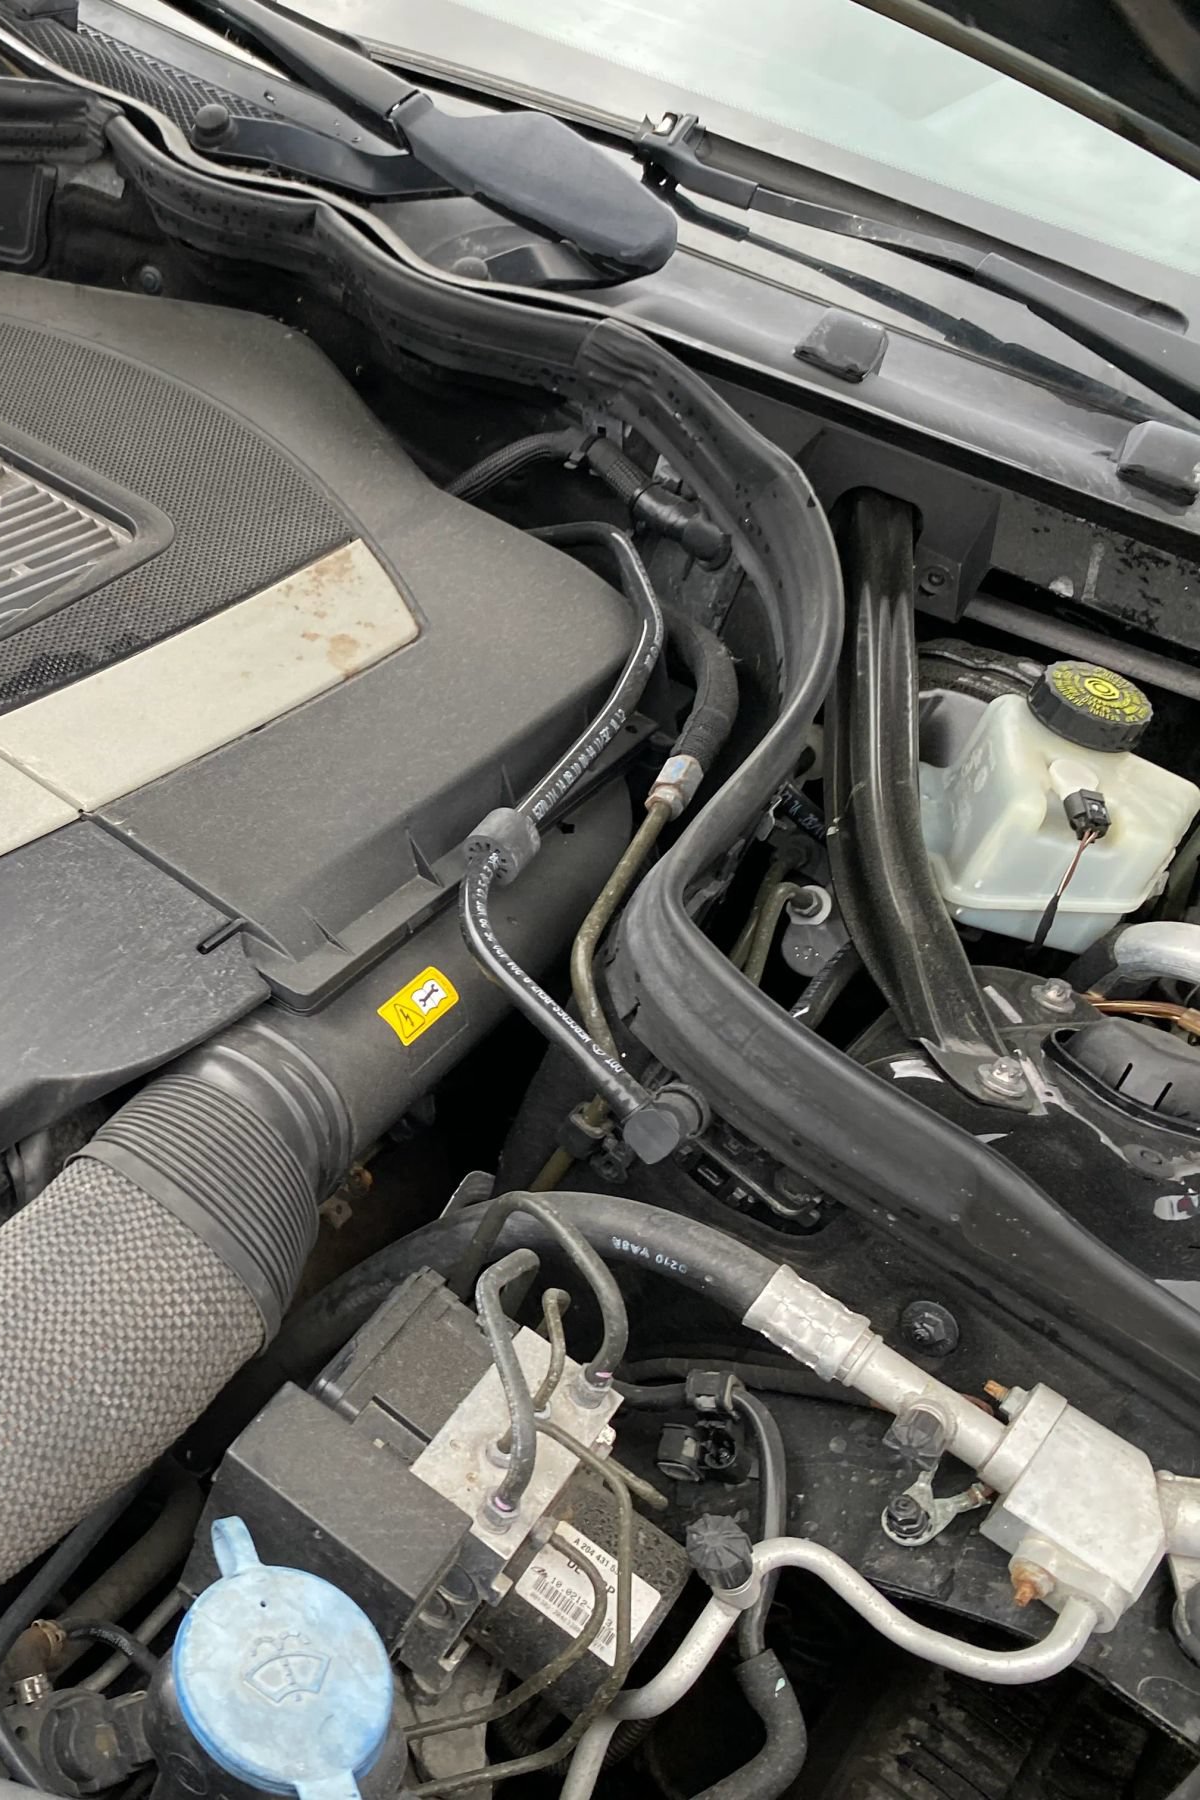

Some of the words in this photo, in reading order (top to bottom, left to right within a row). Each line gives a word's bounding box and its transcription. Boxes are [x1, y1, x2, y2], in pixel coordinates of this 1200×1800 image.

[531, 985, 592, 1043] MERCEDES-BENZ
[573, 1538, 581, 1546] A
[580, 1542, 596, 1557] 204
[595, 1553, 610, 1567] 431
